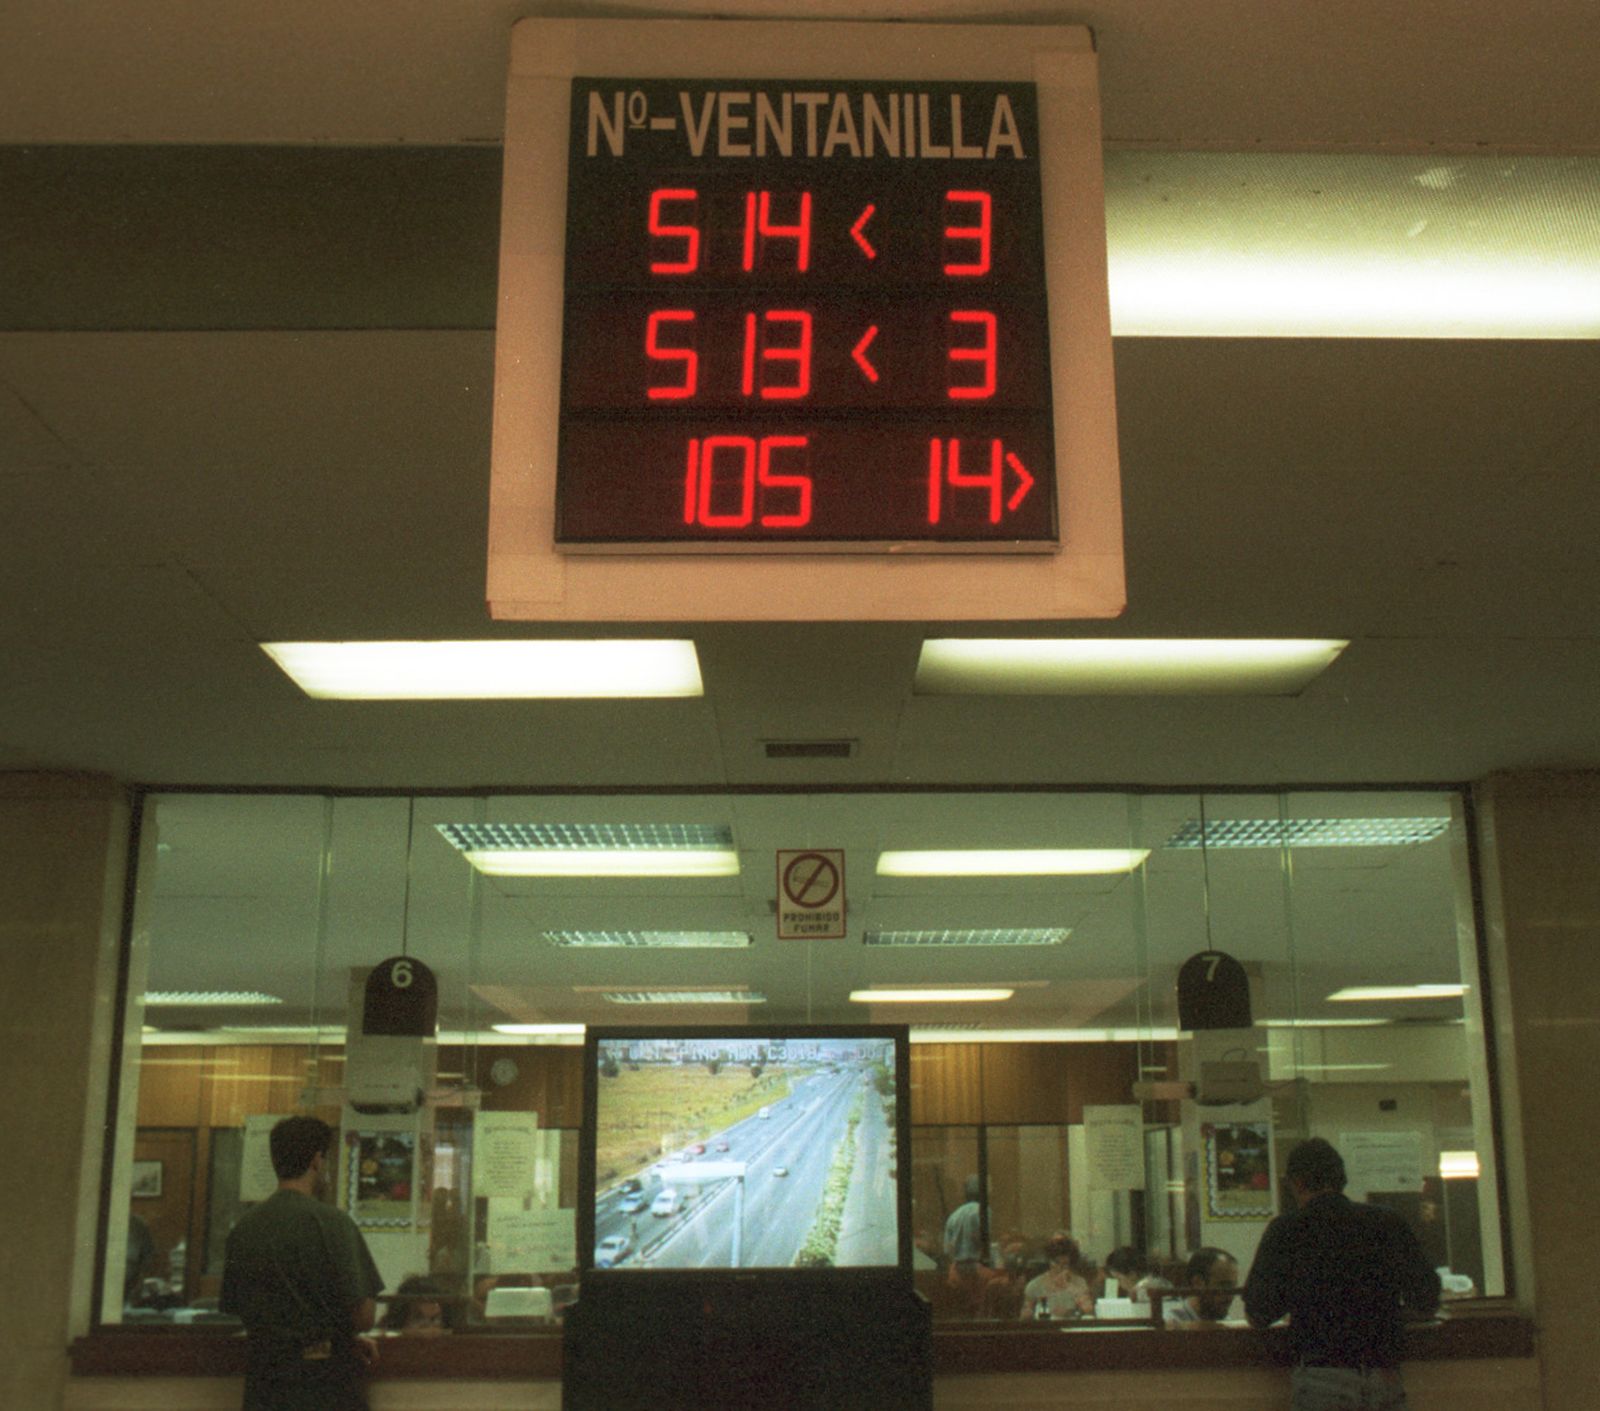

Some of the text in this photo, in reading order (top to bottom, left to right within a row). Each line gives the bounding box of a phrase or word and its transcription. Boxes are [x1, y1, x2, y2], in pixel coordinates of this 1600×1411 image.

[944, 191, 991, 276] 3
[948, 311, 996, 399] 3
[684, 436, 1003, 528] 105 14
[391, 961, 413, 988] 6
[1202, 955, 1220, 982] 7
